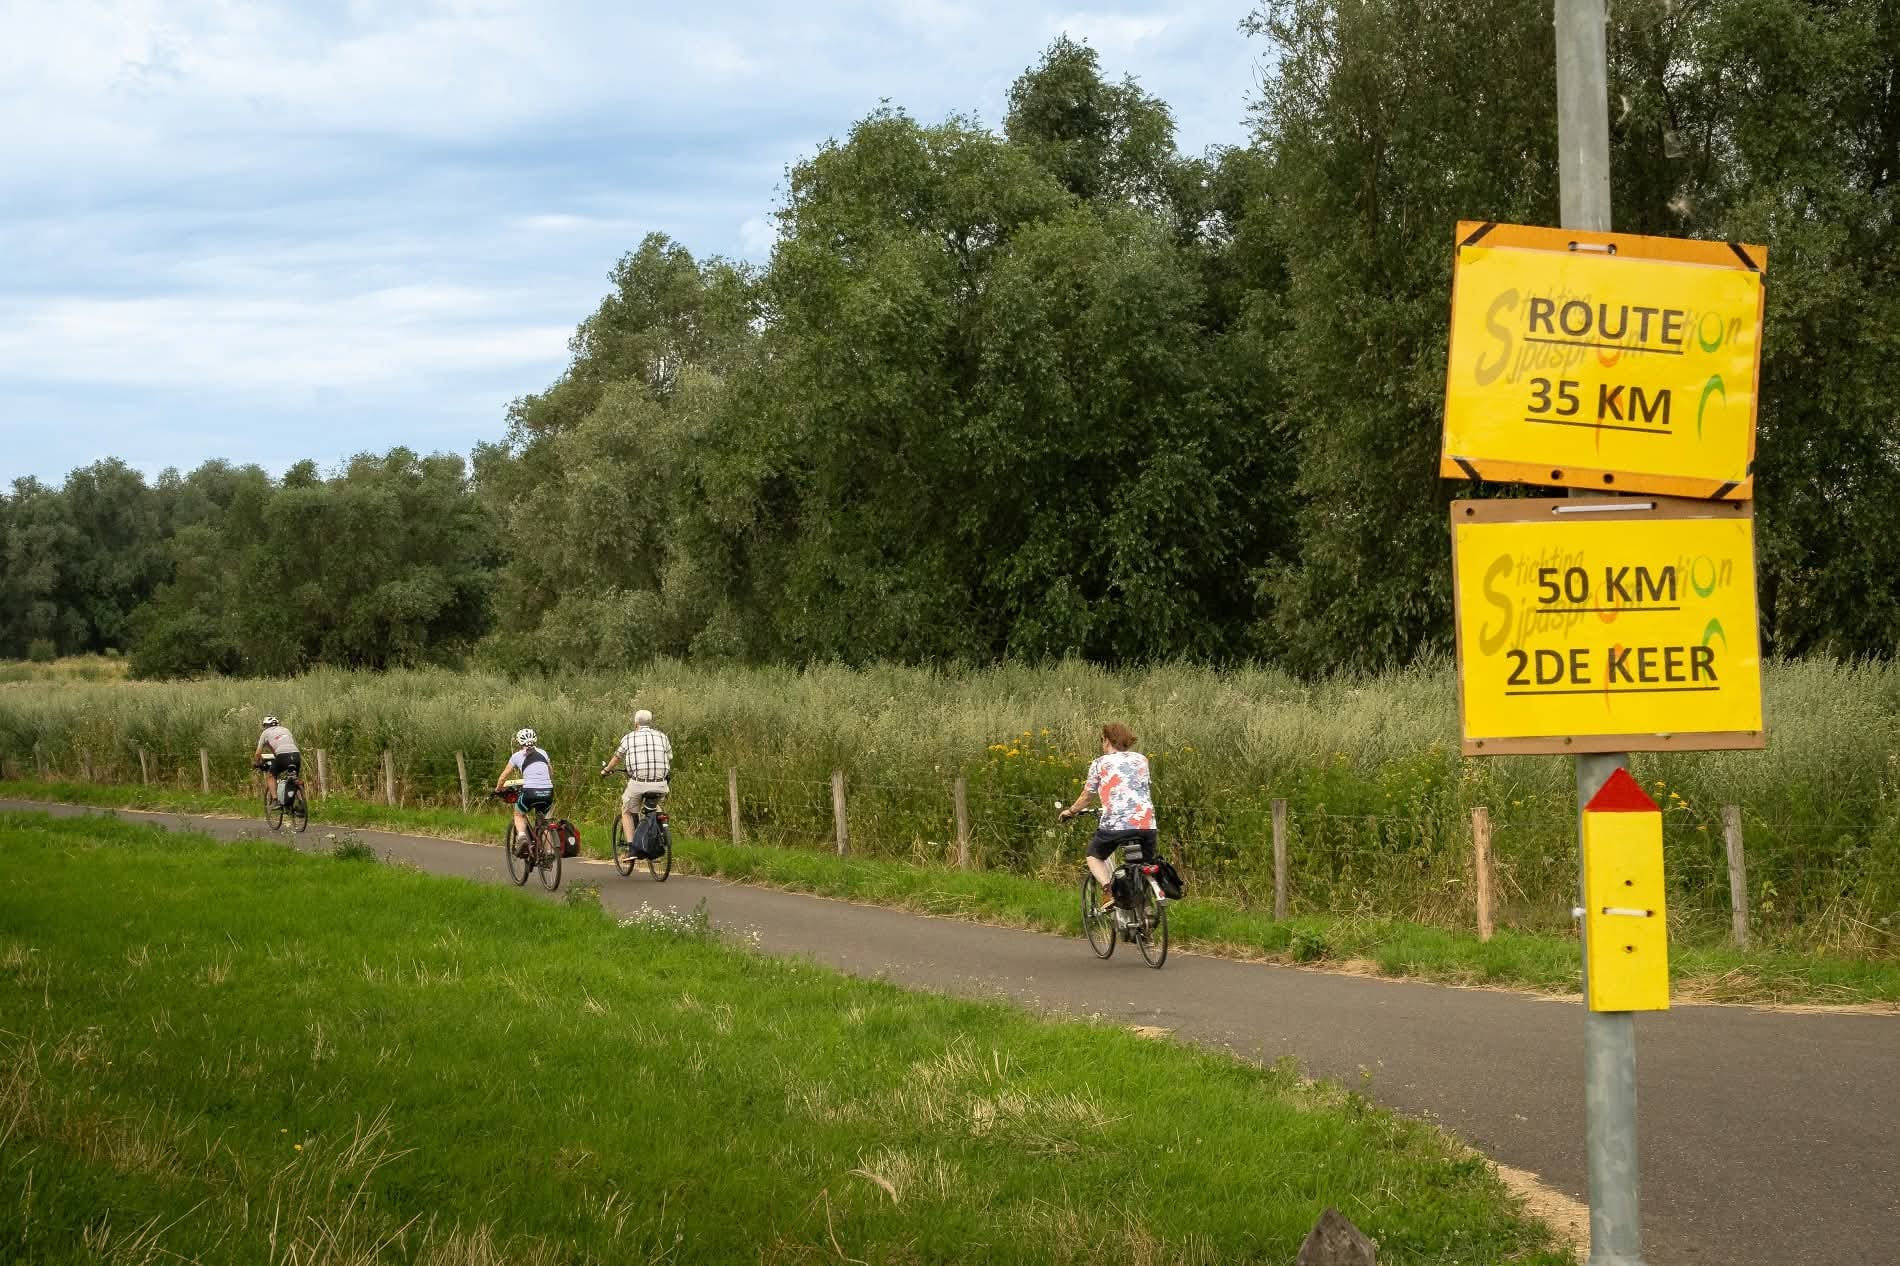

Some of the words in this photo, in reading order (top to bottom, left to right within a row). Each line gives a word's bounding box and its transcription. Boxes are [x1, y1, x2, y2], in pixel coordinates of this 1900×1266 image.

[1528, 297, 1685, 346] ROUTE
[1527, 377, 1580, 416] 35
[1597, 383, 1672, 425] KM
[1537, 566, 1589, 604] 50
[1605, 565, 1677, 602] KM
[1505, 647, 1591, 687] 2DE
[1608, 645, 1719, 684] KEER
